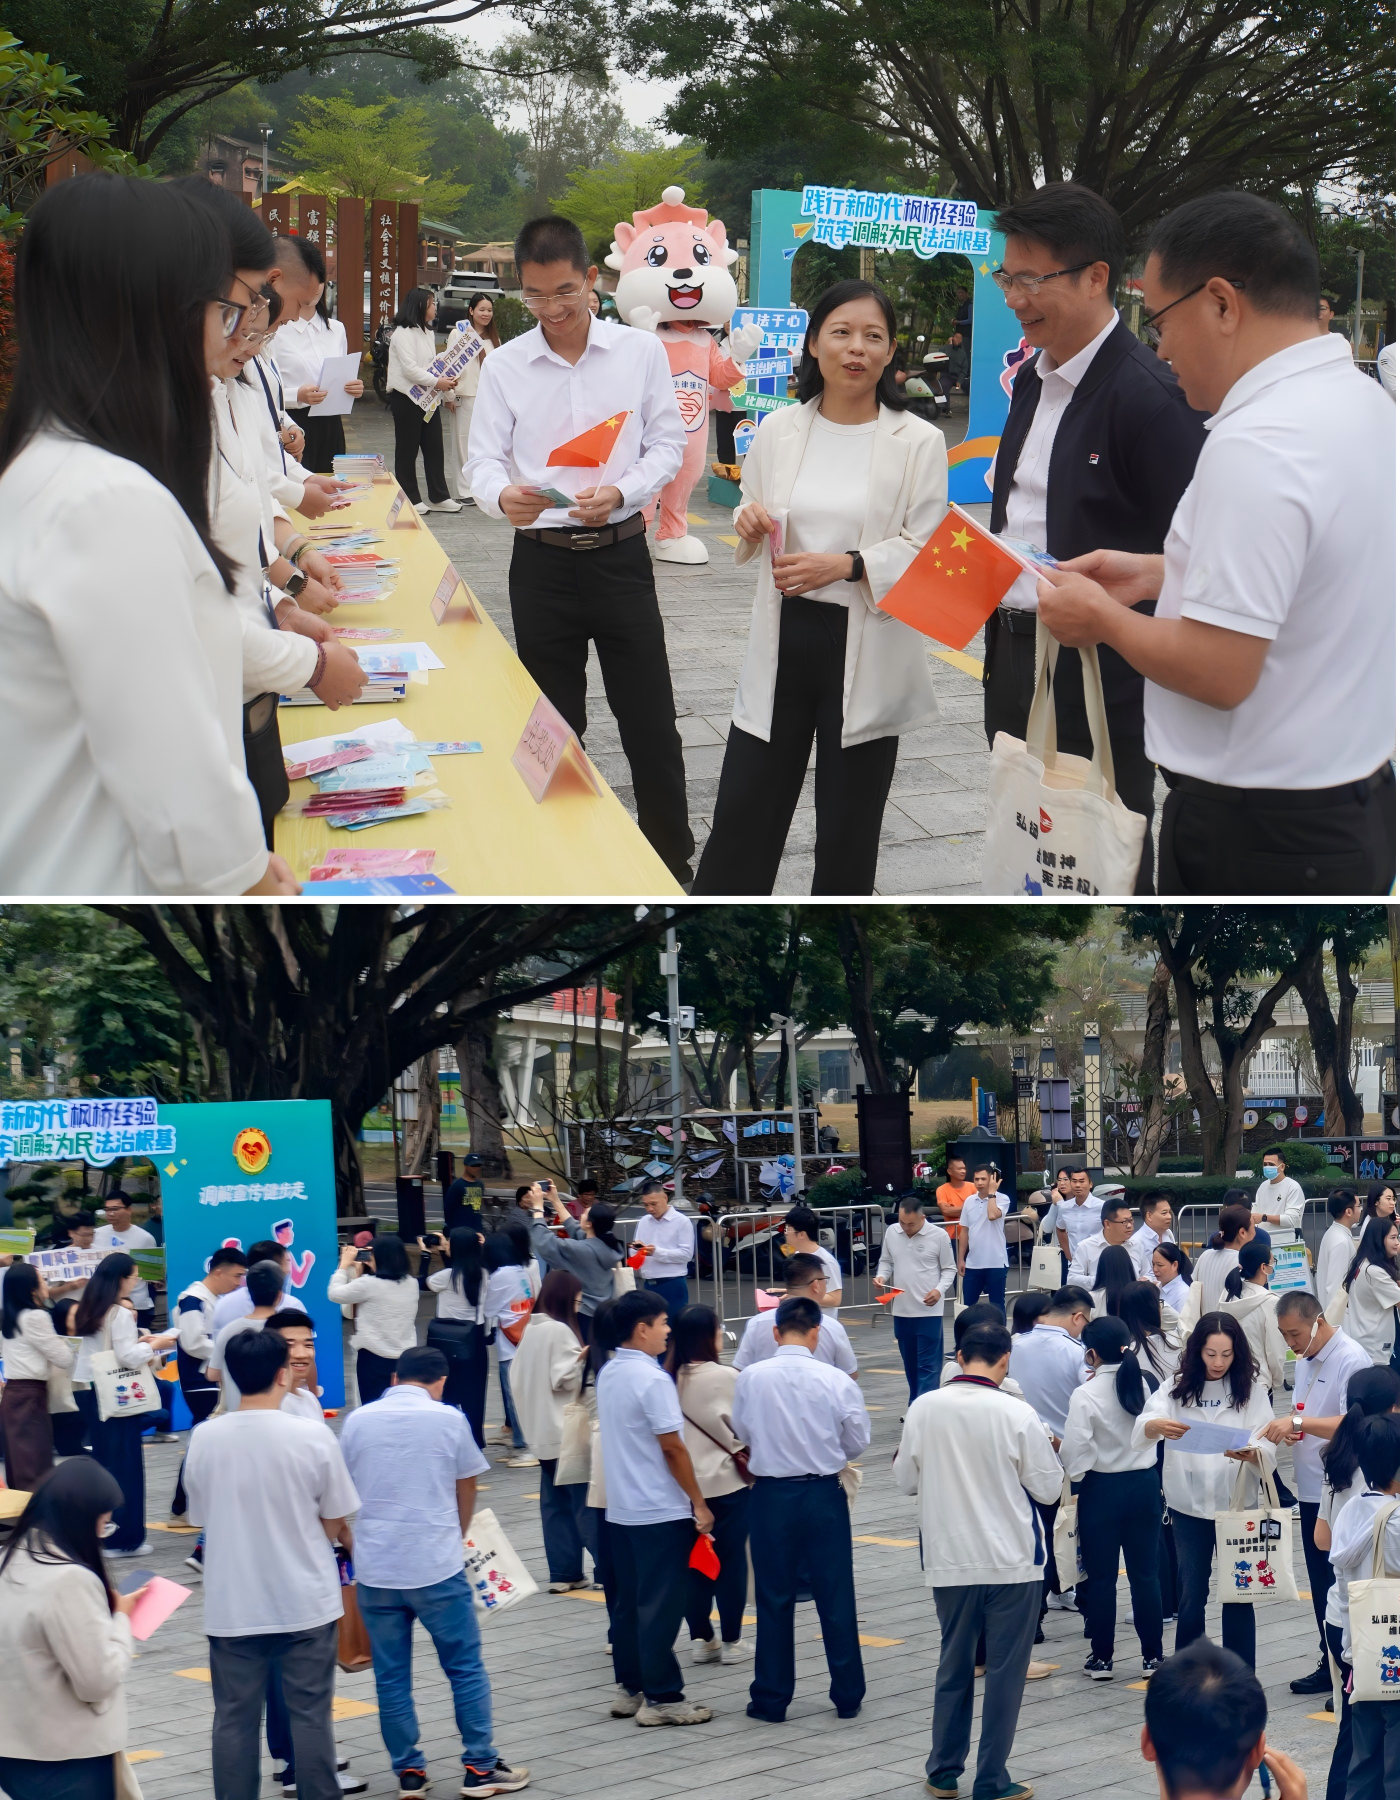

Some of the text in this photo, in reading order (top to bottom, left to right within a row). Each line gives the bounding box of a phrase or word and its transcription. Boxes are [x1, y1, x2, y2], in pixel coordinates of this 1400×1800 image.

[803, 188, 976, 228] 践行新时代枫桥经验
[814, 218, 989, 256] 筑牢调解为民法治根基
